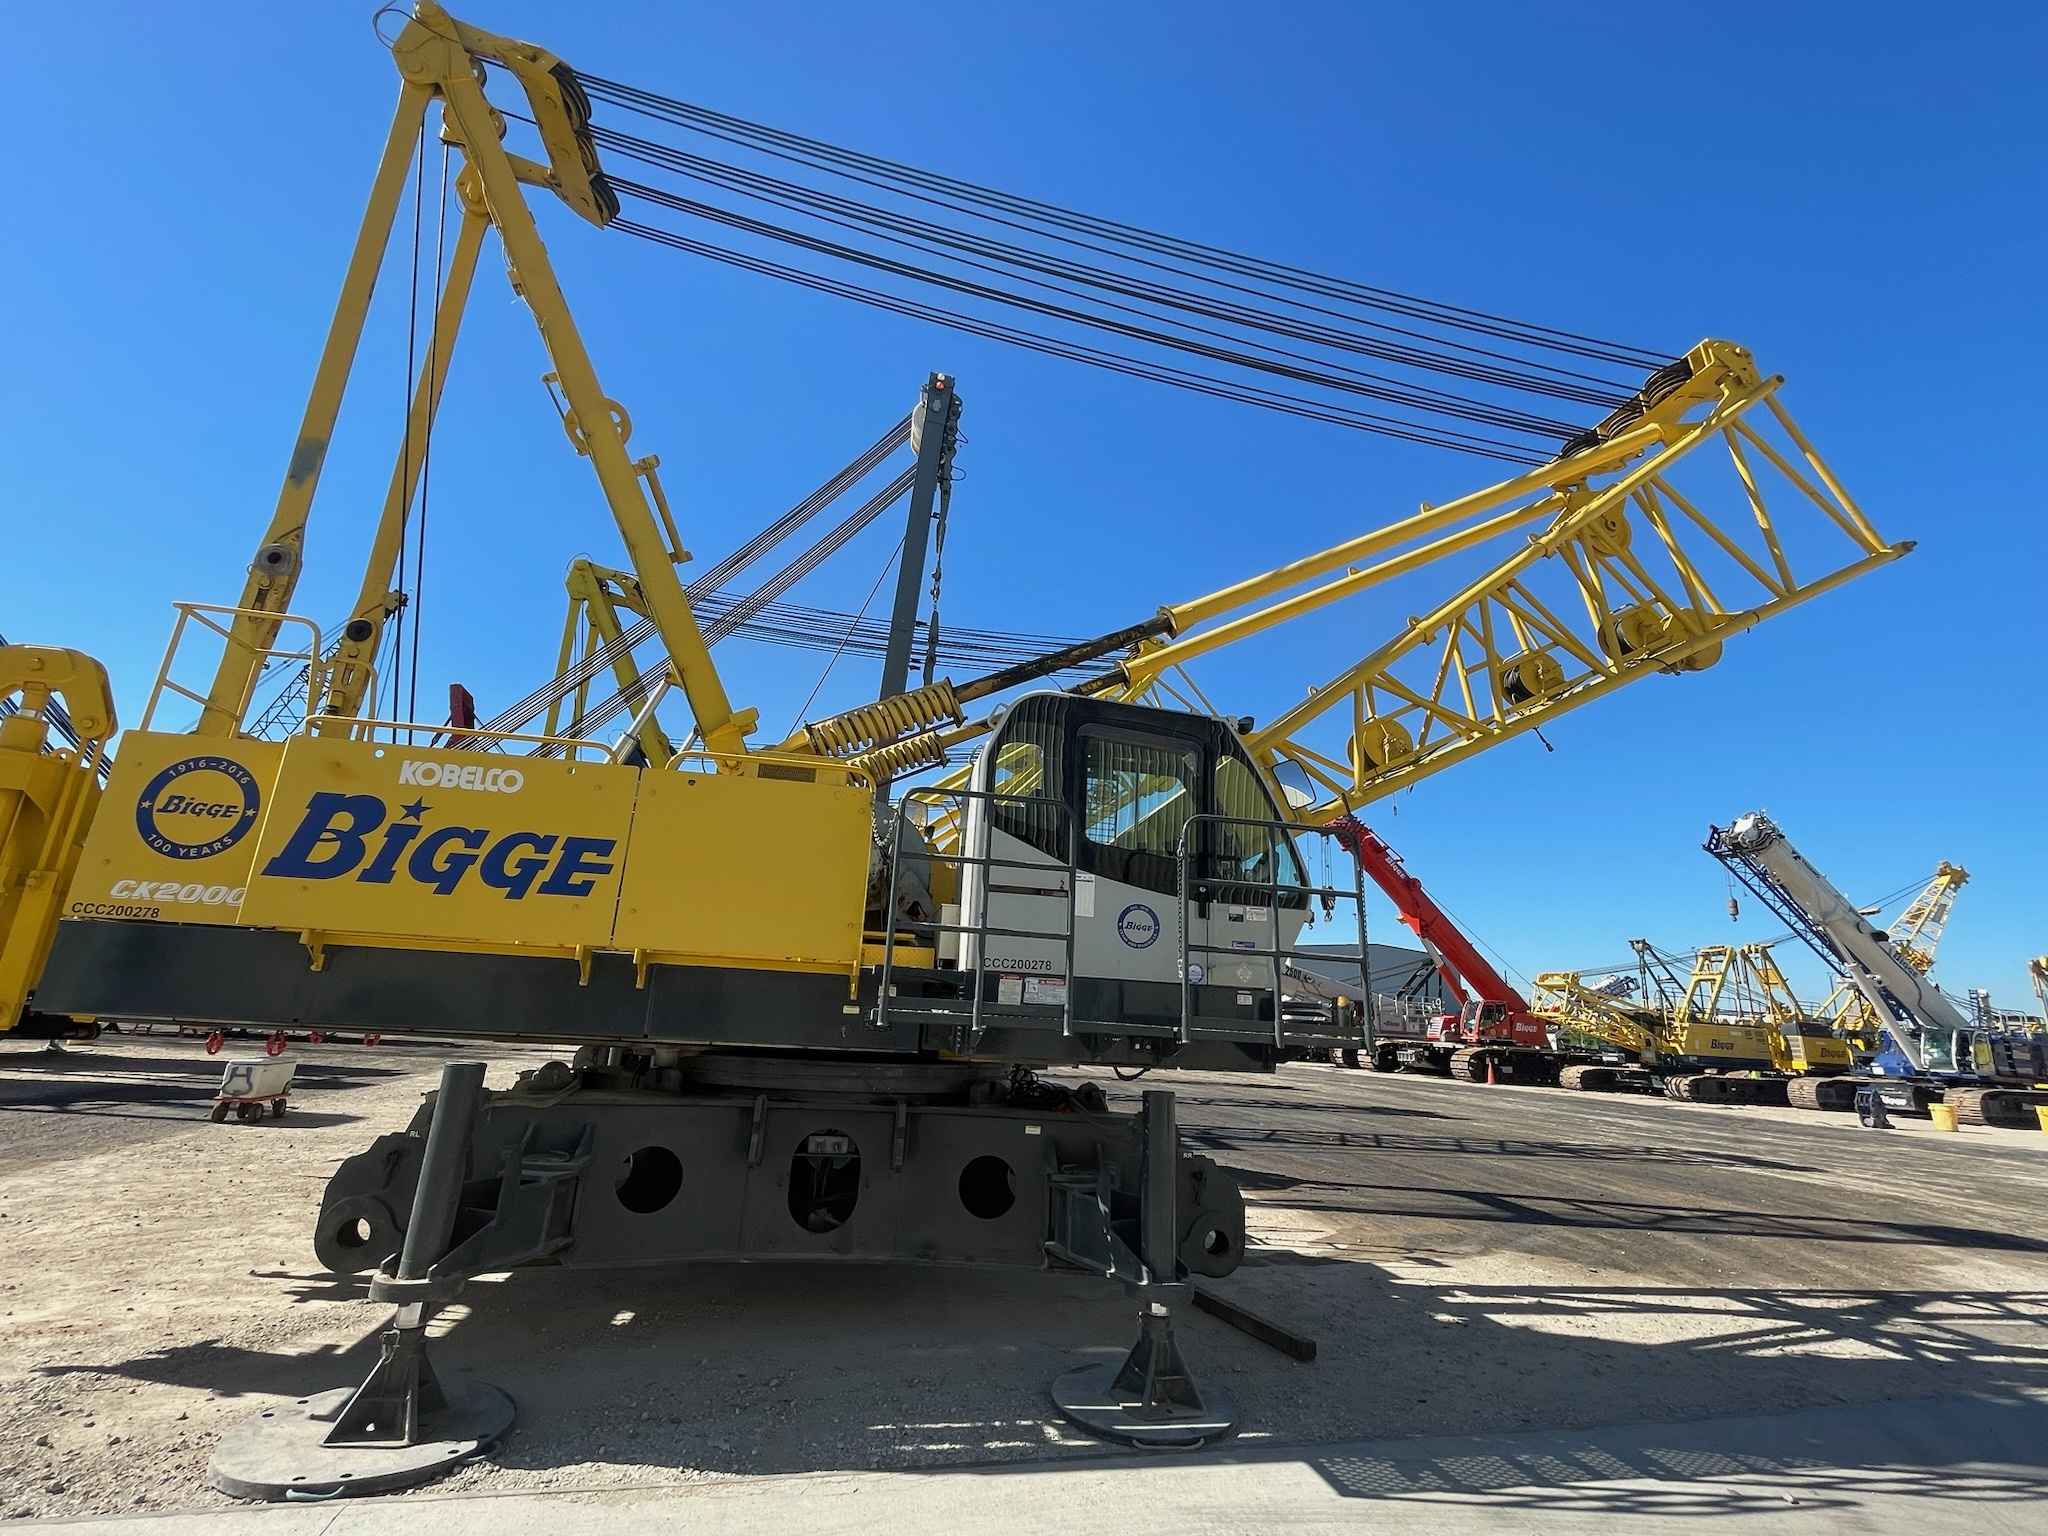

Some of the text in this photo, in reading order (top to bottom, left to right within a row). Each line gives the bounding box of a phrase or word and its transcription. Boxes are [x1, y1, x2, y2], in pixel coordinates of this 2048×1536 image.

[168, 758, 250, 785] 1916-2016
[398, 760, 525, 794] KOBELCO
[147, 832, 234, 858] 100 YEARS
[71, 901, 161, 919] CCC200278
[983, 957, 1053, 971] CCC200278
